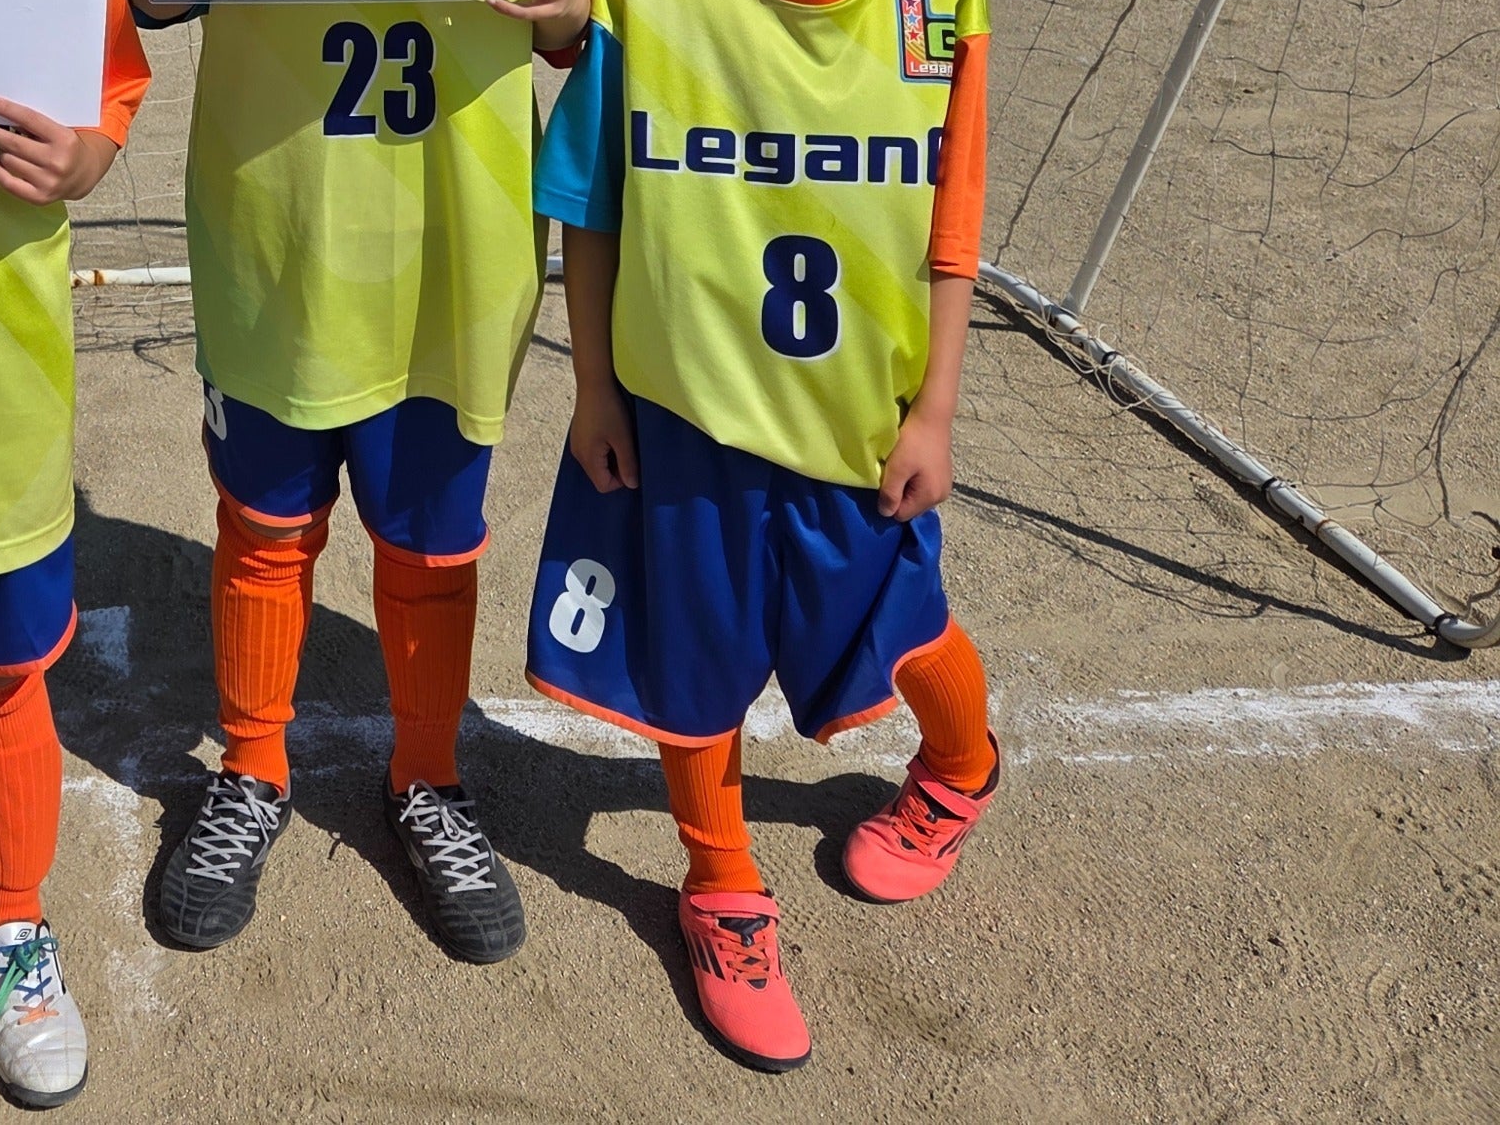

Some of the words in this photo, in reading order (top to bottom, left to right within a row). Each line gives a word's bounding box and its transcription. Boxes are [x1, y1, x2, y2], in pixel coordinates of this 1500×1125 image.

[321, 21, 437, 138] 23
[910, 61, 954, 76] Legan
[760, 233, 841, 359] 8
[549, 558, 616, 653] 8
